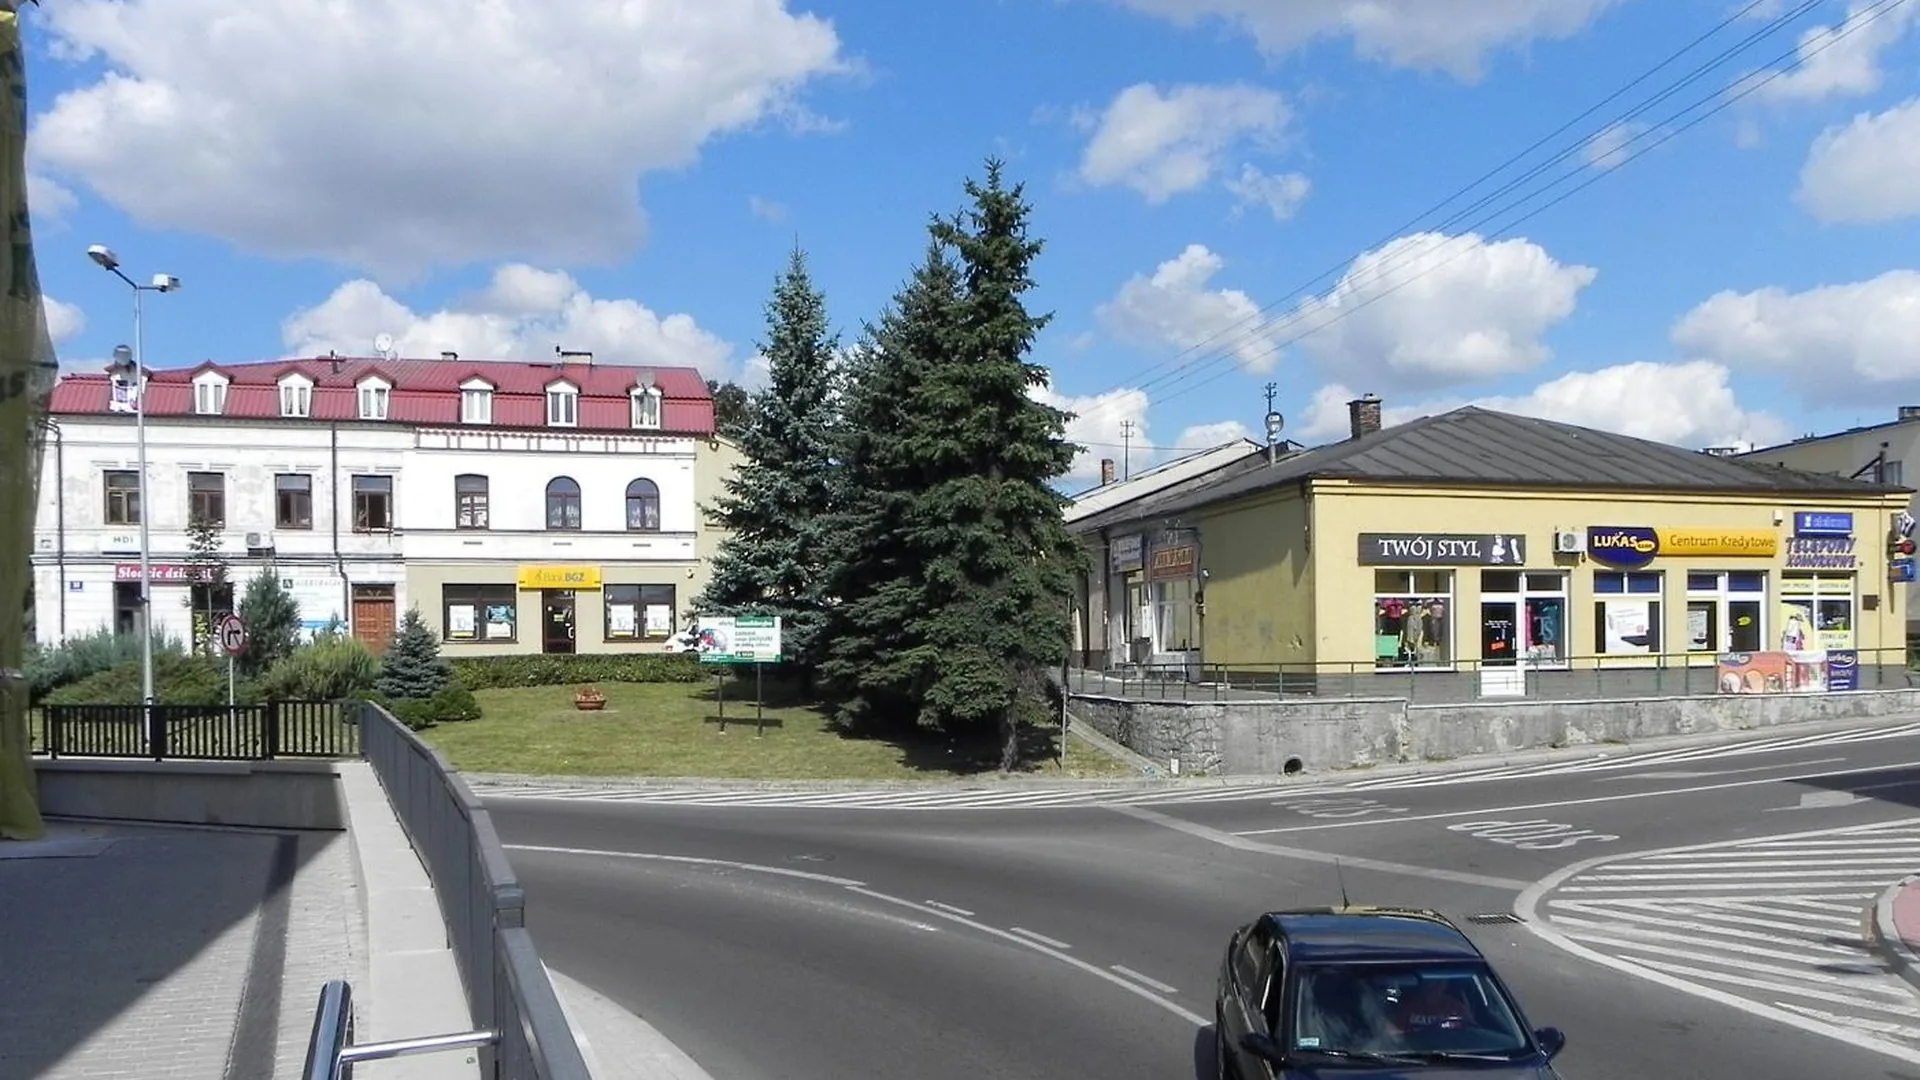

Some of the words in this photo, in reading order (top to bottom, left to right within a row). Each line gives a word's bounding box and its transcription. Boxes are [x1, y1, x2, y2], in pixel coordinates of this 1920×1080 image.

[1378, 536, 1433, 560] TWÓJ
[1438, 540, 1481, 558] STYL
[1594, 532, 1637, 548] LUKAS
[1670, 535, 1717, 547] Centrum
[1721, 535, 1775, 550] Kredytowe
[1447, 819, 1621, 849] STOP
